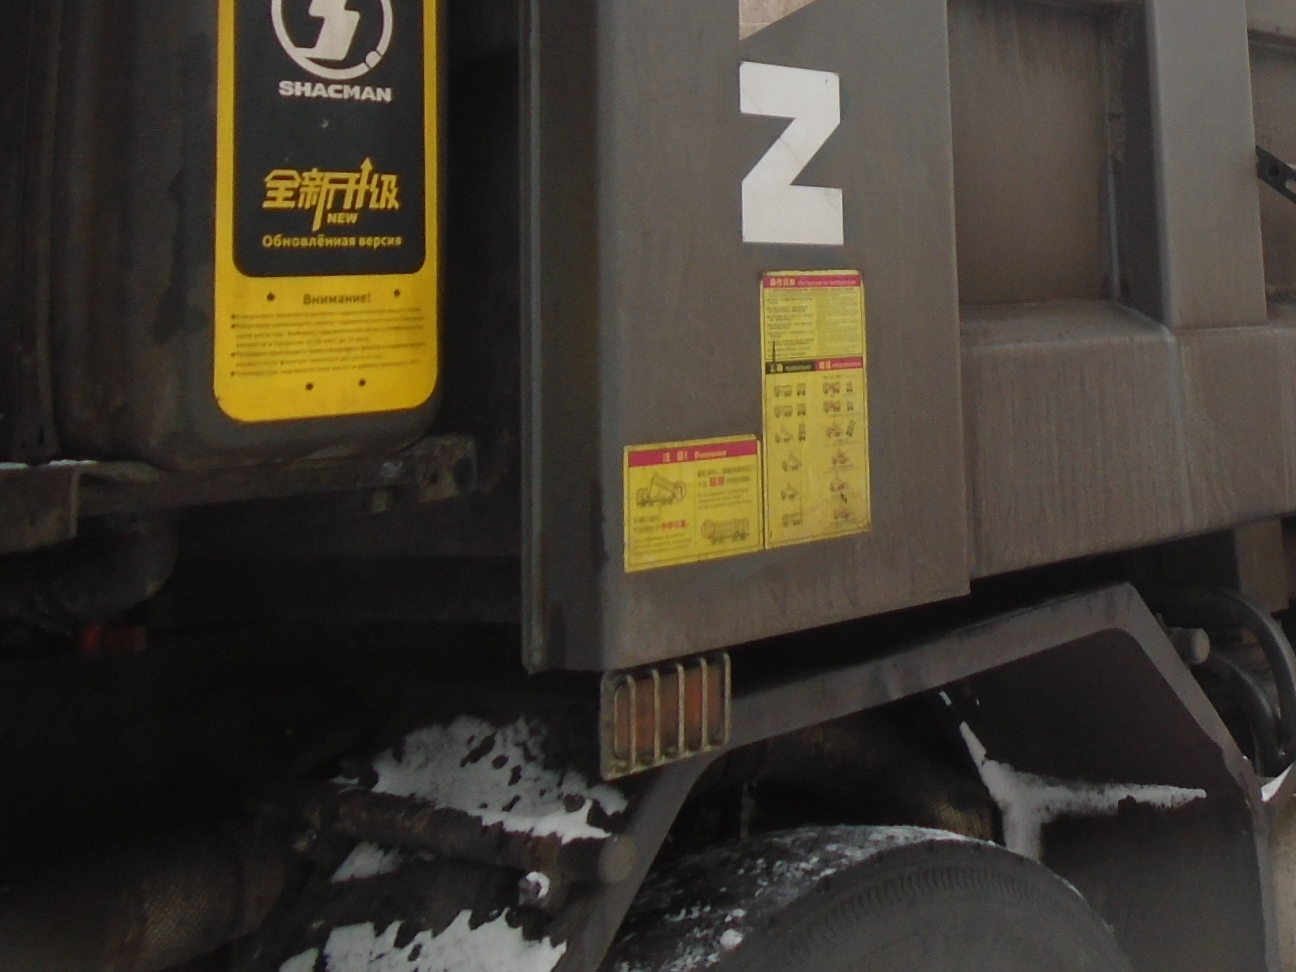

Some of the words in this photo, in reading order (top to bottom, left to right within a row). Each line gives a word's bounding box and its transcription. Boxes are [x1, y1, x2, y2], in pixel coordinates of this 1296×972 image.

[278, 80, 393, 103] SHACMAN
[326, 212, 359, 224] NEW
[262, 234, 356, 248] Обновлённая
[359, 235, 402, 248] версия
[303, 292, 371, 305] Внимание!
